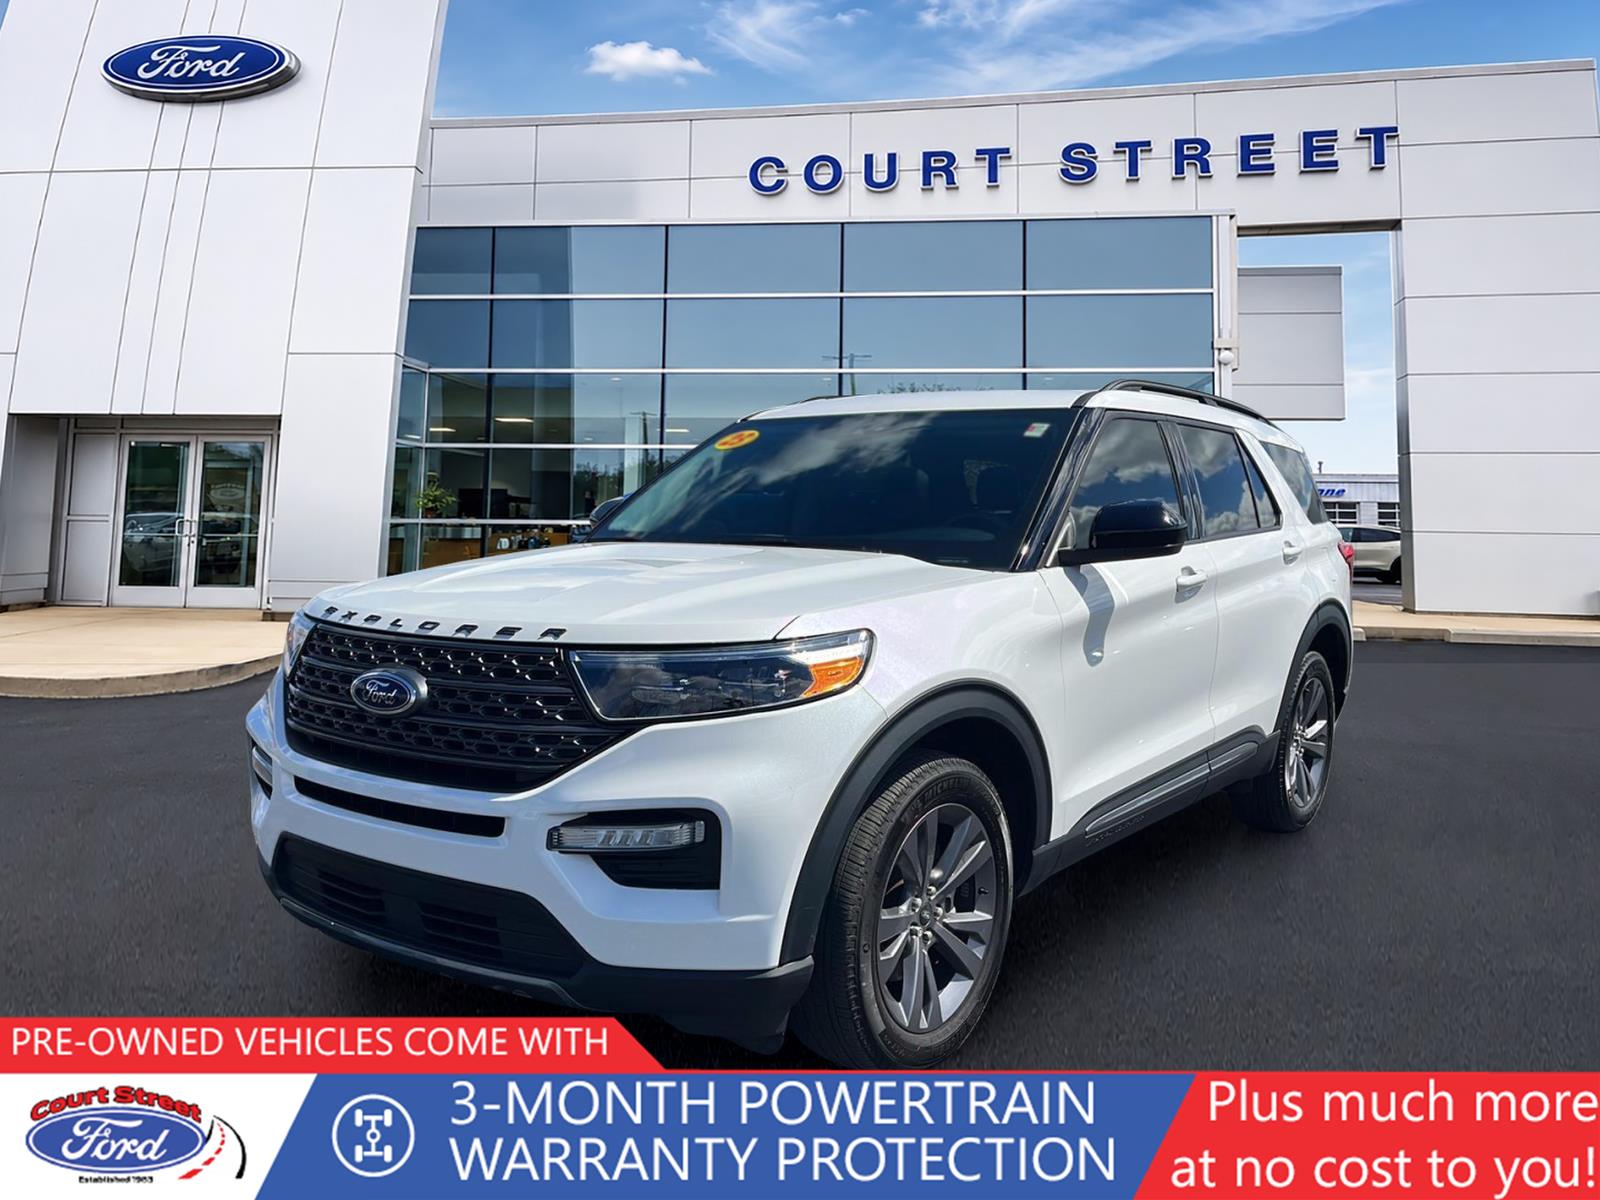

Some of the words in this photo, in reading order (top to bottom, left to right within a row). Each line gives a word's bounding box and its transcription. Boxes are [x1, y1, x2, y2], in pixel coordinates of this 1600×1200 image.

[136, 44, 247, 79] Ford
[748, 146, 1011, 196] COURT
[1060, 125, 1399, 184] STREET
[324, 606, 567, 638] EXPLORER
[363, 679, 399, 706] Ford
